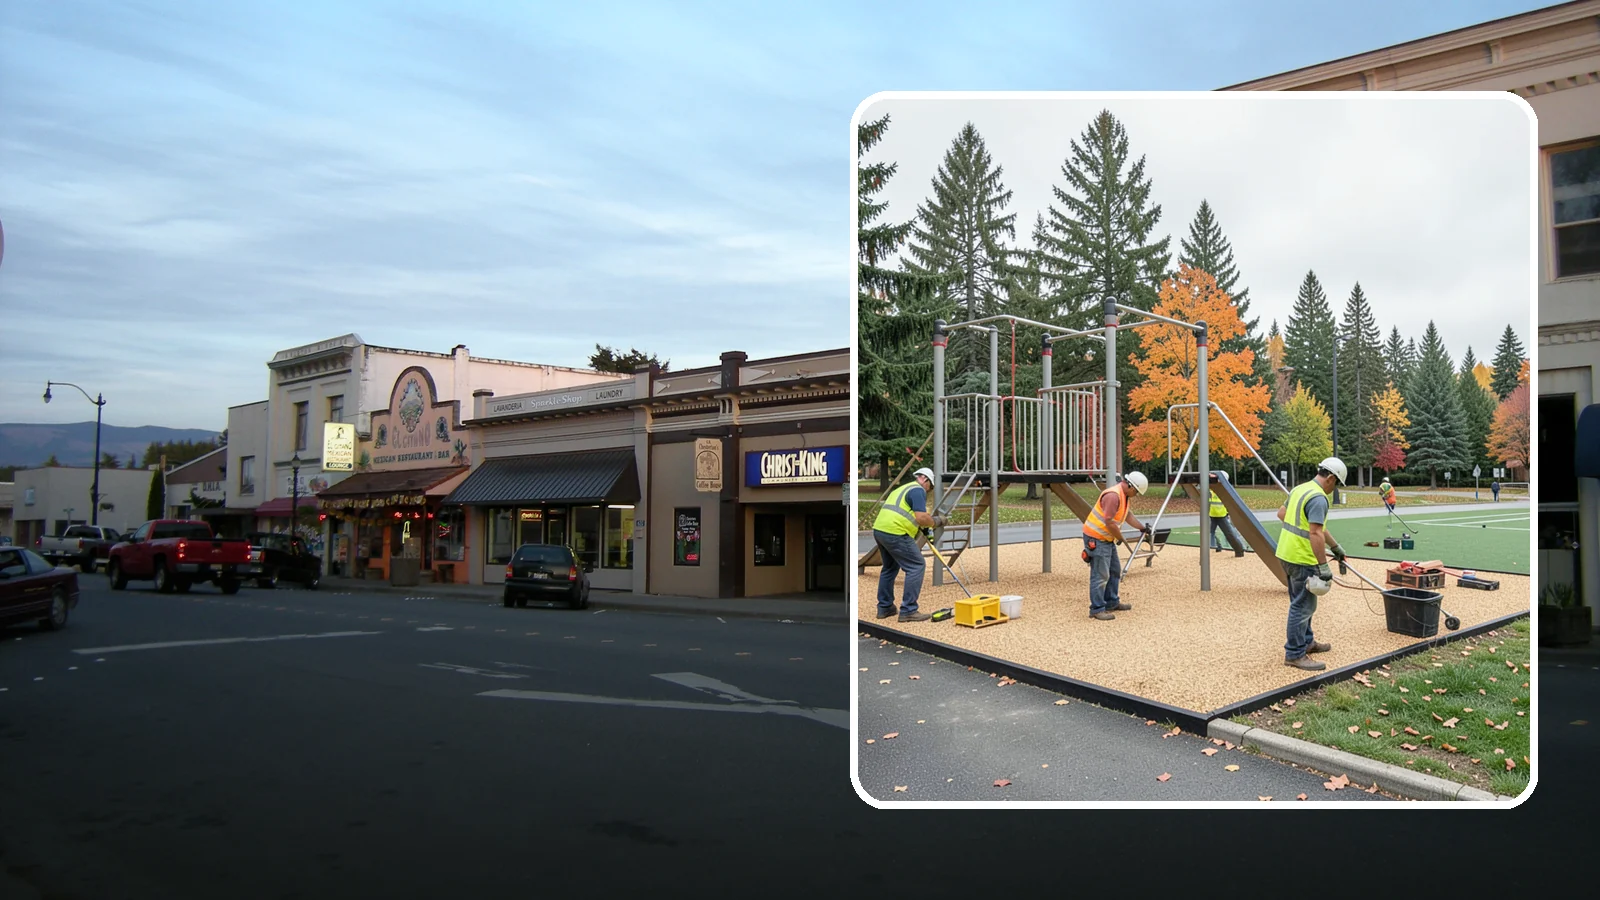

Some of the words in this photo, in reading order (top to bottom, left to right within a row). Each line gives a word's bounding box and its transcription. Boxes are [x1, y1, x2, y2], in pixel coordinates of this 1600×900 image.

[595, 388, 623, 400] LAUNDRY
[493, 403, 522, 412] LAVANDERIA
[530, 397, 560, 409] Sparkle
[561, 395, 582, 405] Shop
[373, 454, 396, 464] MEXICAN
[397, 451, 433, 462] RESTAURANT
[438, 450, 450, 459] BAR
[760, 452, 797, 478] CHRIST
[798, 449, 827, 476] KING
